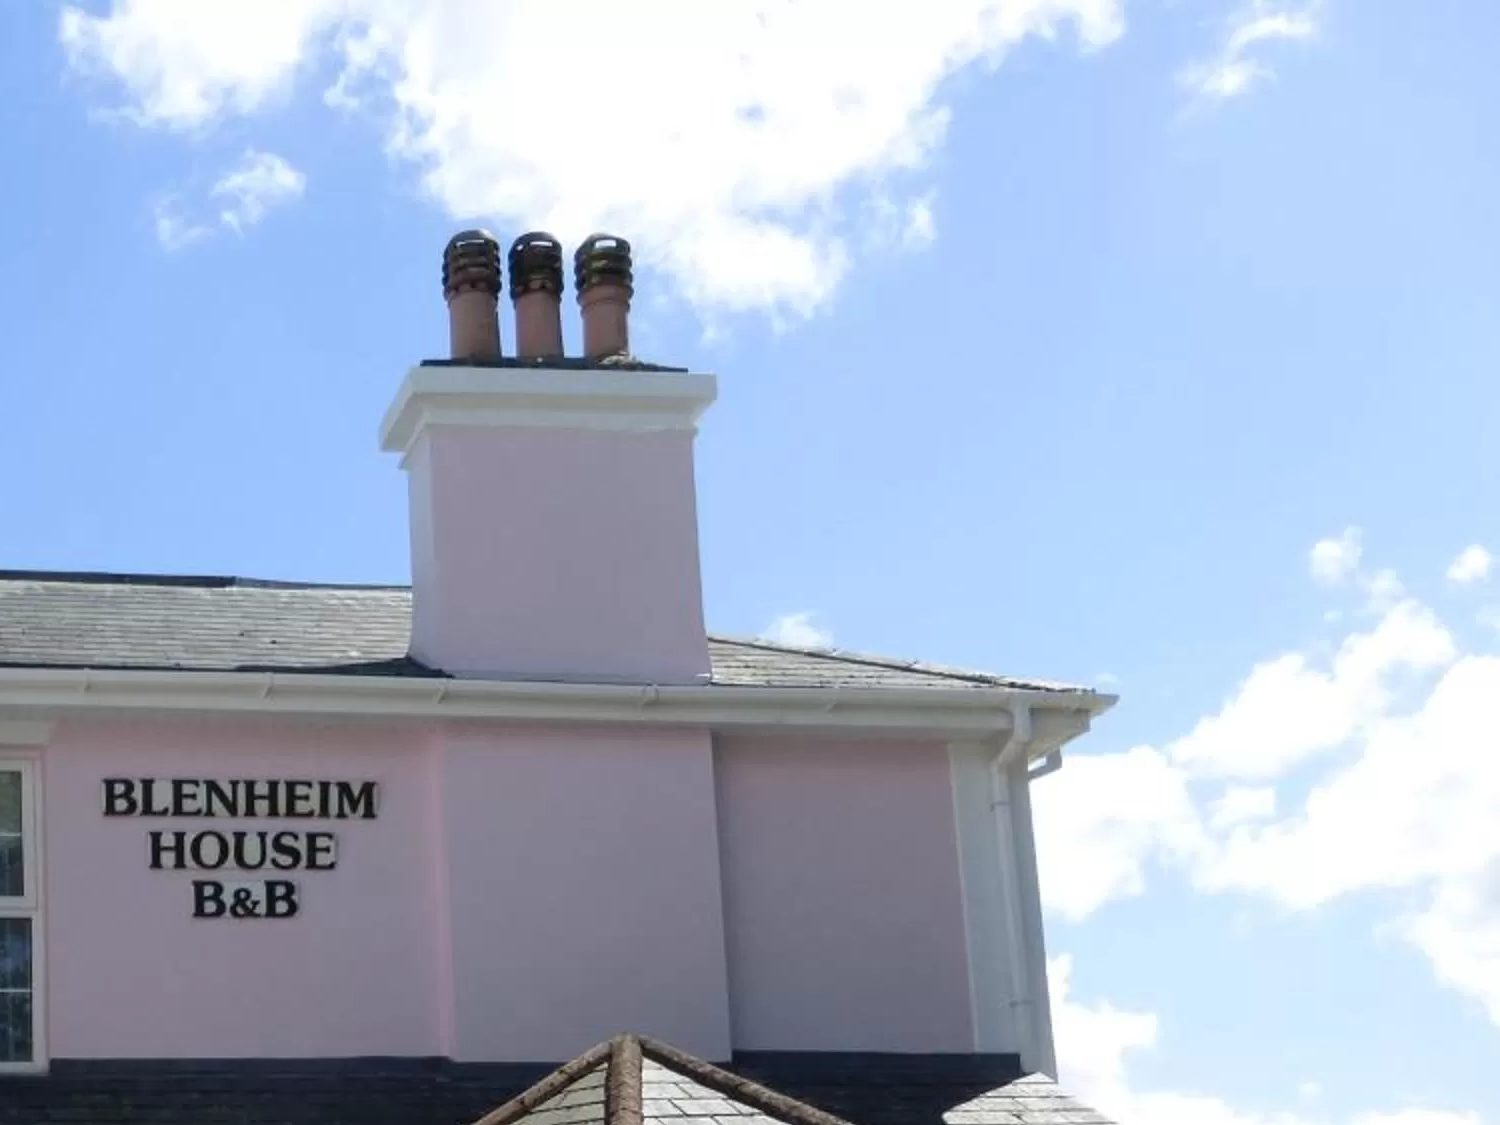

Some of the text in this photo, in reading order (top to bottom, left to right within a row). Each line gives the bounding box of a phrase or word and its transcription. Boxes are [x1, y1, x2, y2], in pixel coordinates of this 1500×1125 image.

[102, 778, 377, 819] BLENHEIM
[149, 830, 336, 870] HOUSE
[192, 880, 298, 918] B&B
